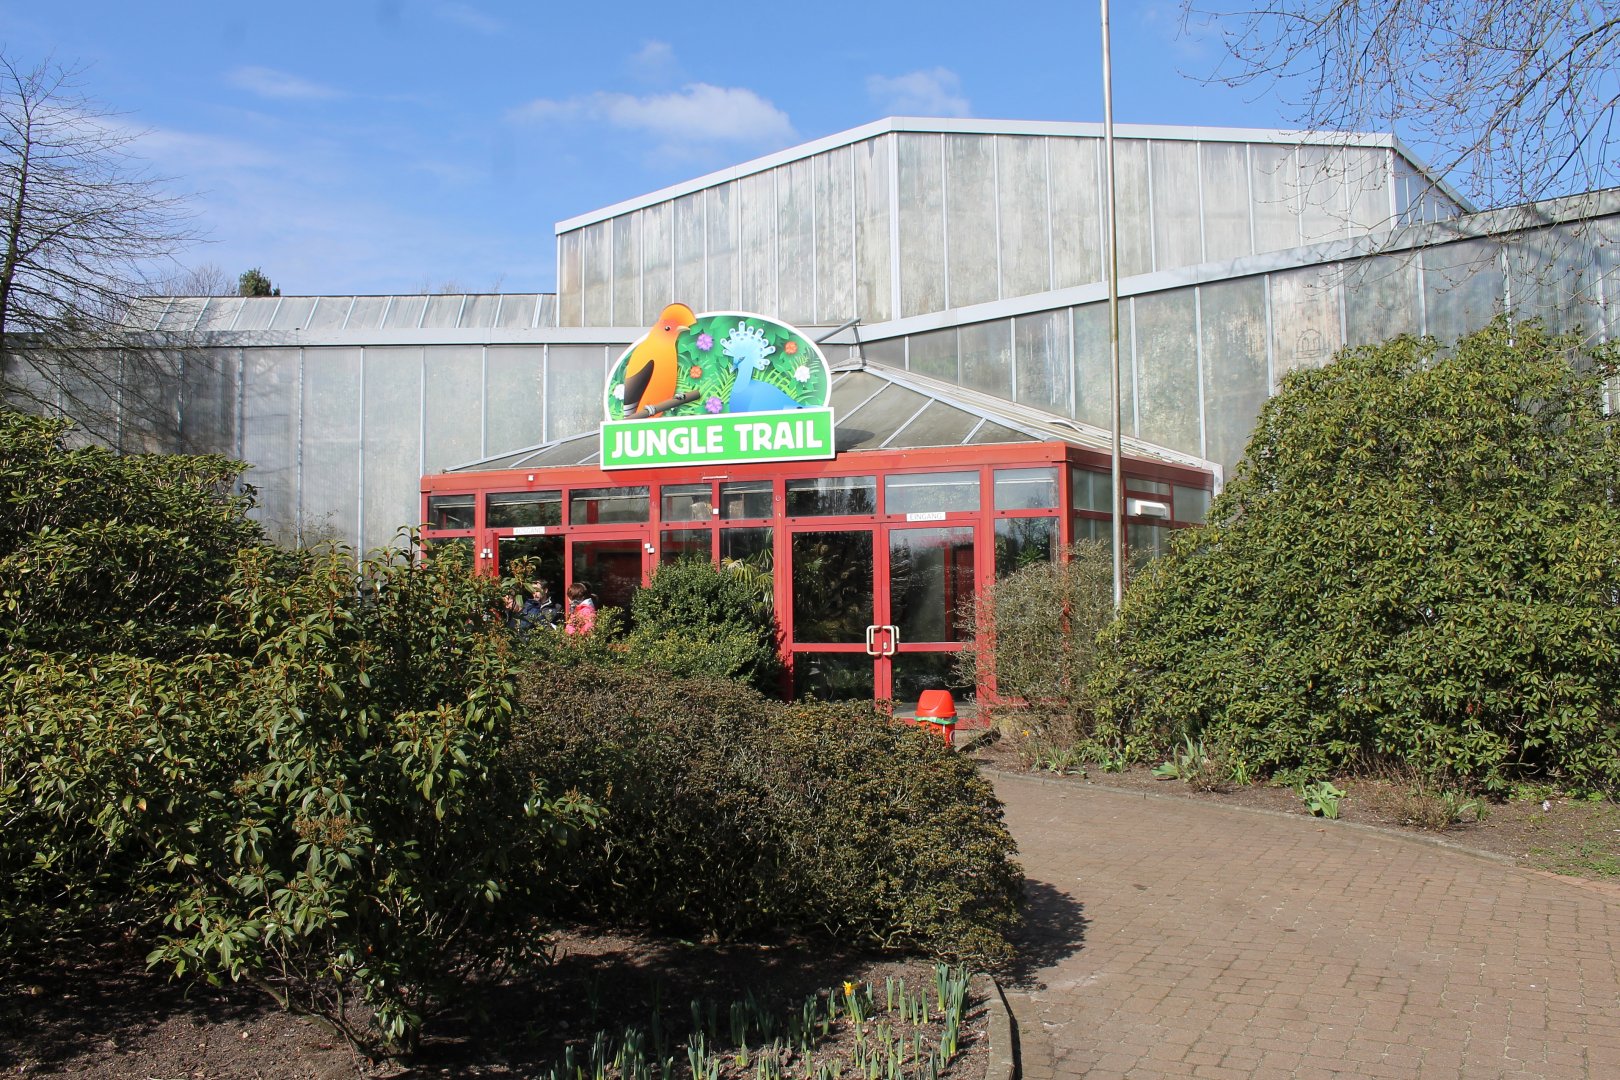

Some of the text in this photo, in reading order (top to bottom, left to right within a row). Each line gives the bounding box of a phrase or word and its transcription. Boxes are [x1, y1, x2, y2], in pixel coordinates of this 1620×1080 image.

[611, 420, 823, 458] JUNGLE TRAIL
[909, 512, 943, 520] EINGANG
